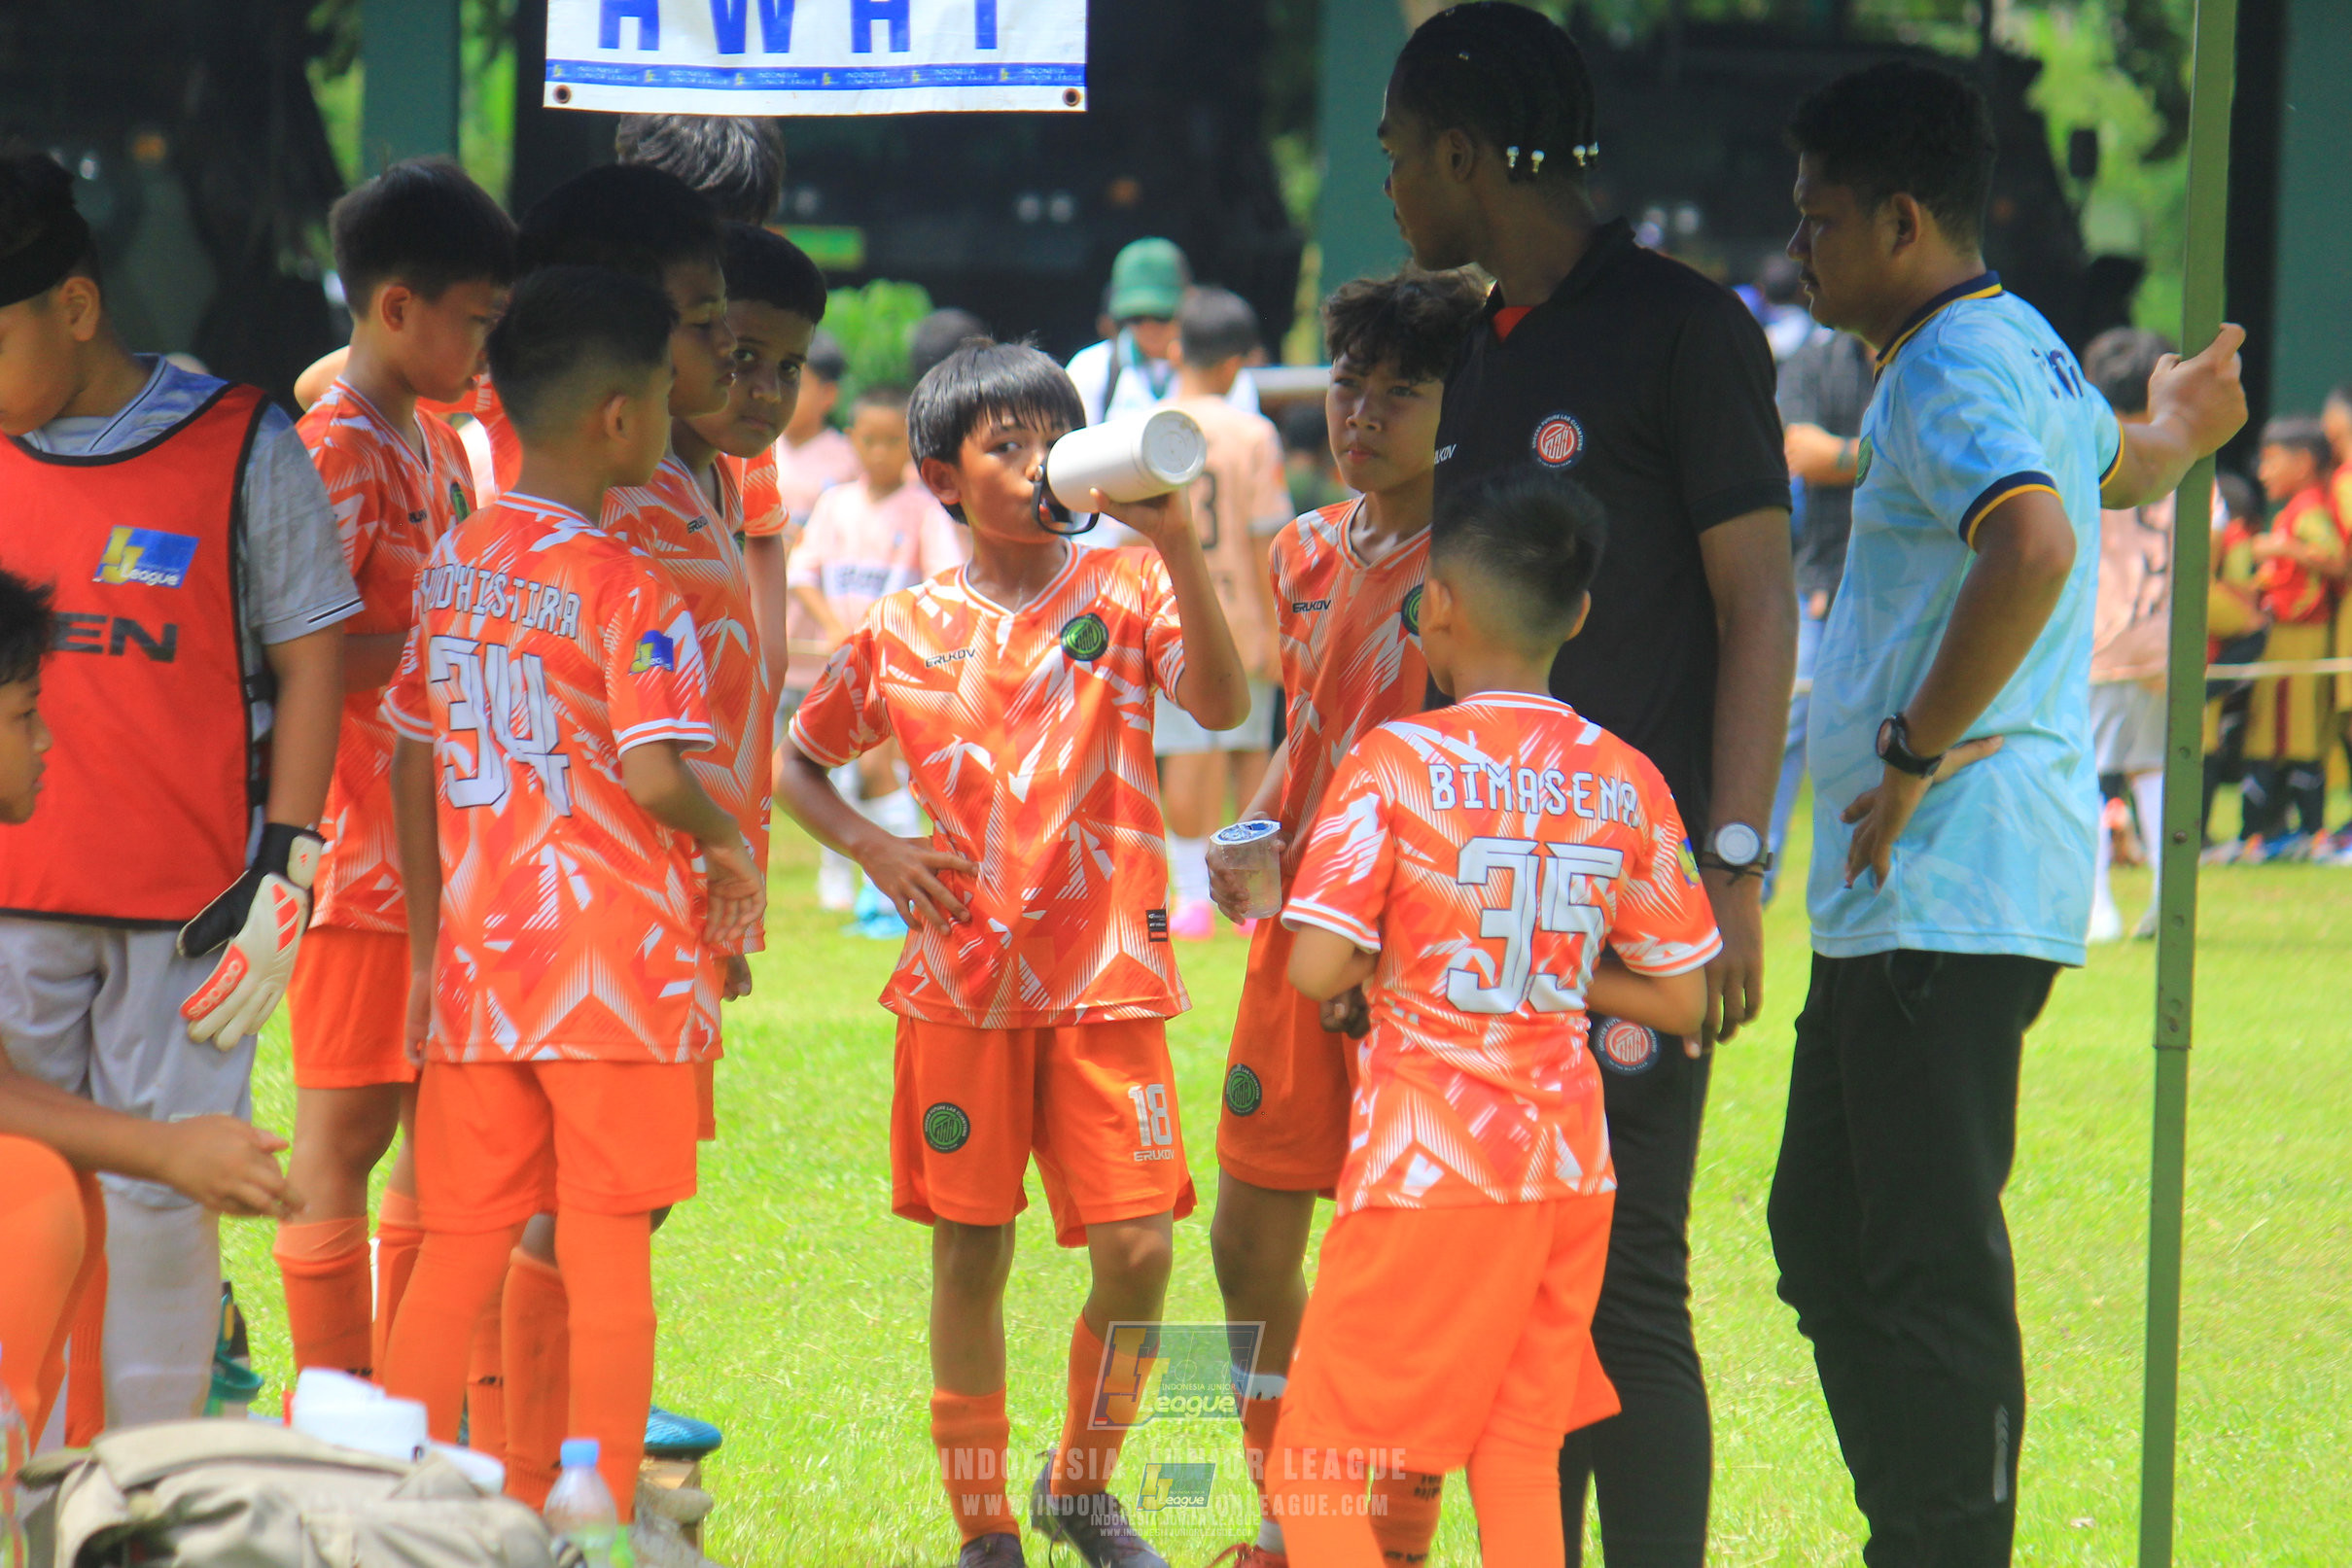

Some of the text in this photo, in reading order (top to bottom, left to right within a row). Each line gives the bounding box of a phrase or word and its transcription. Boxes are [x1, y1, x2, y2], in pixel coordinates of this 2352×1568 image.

[121, 564, 179, 586] League
[1292, 599, 1331, 613] ERUKOV
[926, 648, 975, 668] ERUKOV
[429, 635, 573, 818] 34
[1428, 763, 1640, 828] BIMASENA
[1446, 836, 1625, 1015] 35
[187, 960, 243, 1018] adidas
[1128, 1084, 1173, 1147] 18
